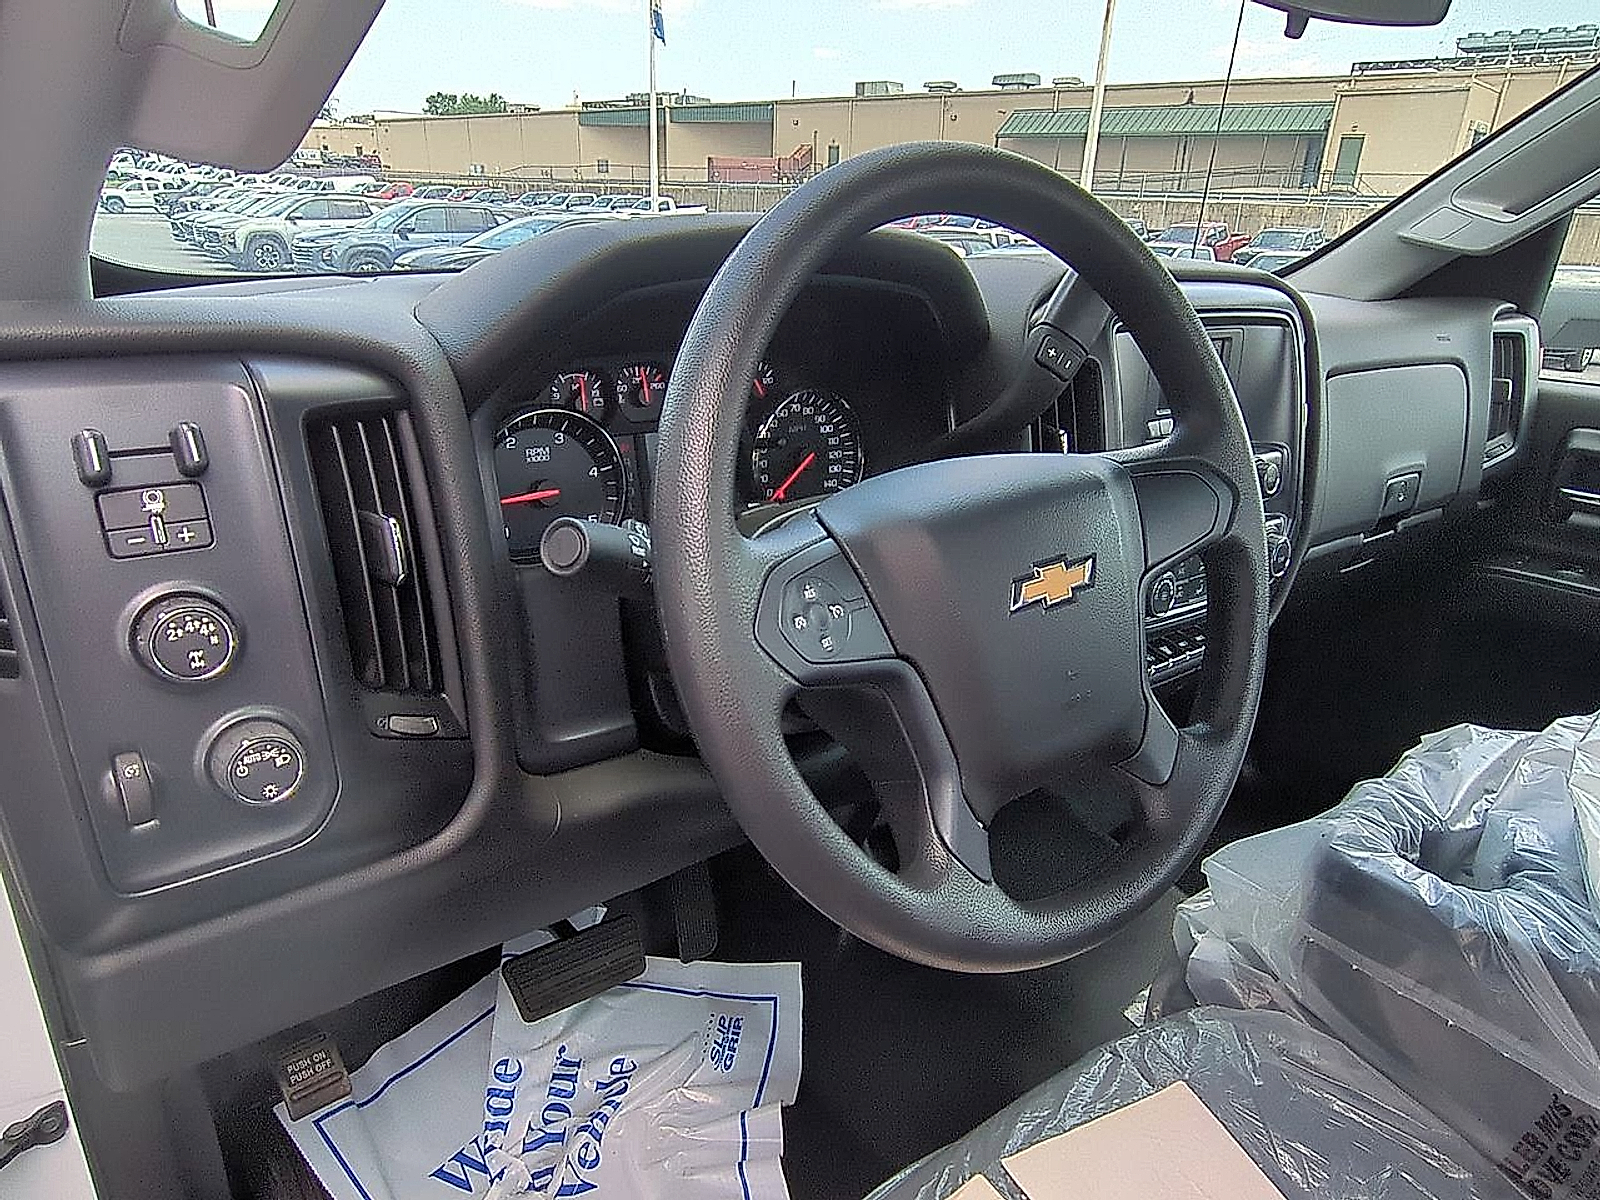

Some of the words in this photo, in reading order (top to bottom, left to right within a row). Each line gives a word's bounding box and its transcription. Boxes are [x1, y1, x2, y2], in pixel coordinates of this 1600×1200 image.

[803, 406, 814, 416] 80
[814, 414, 826, 424] 90
[820, 424, 834, 434] 100
[505, 437, 517, 449] 2
[554, 432, 565, 444] 3
[525, 447, 550, 458] RPM
[588, 466, 599, 478] 4
[588, 514, 598, 523] 5
[287, 1057, 312, 1075] PUSH
[312, 1049, 327, 1063] ON
[289, 1068, 315, 1085] PUSH
[315, 1058, 332, 1073] OFF
[521, 1044, 583, 1155] Your
